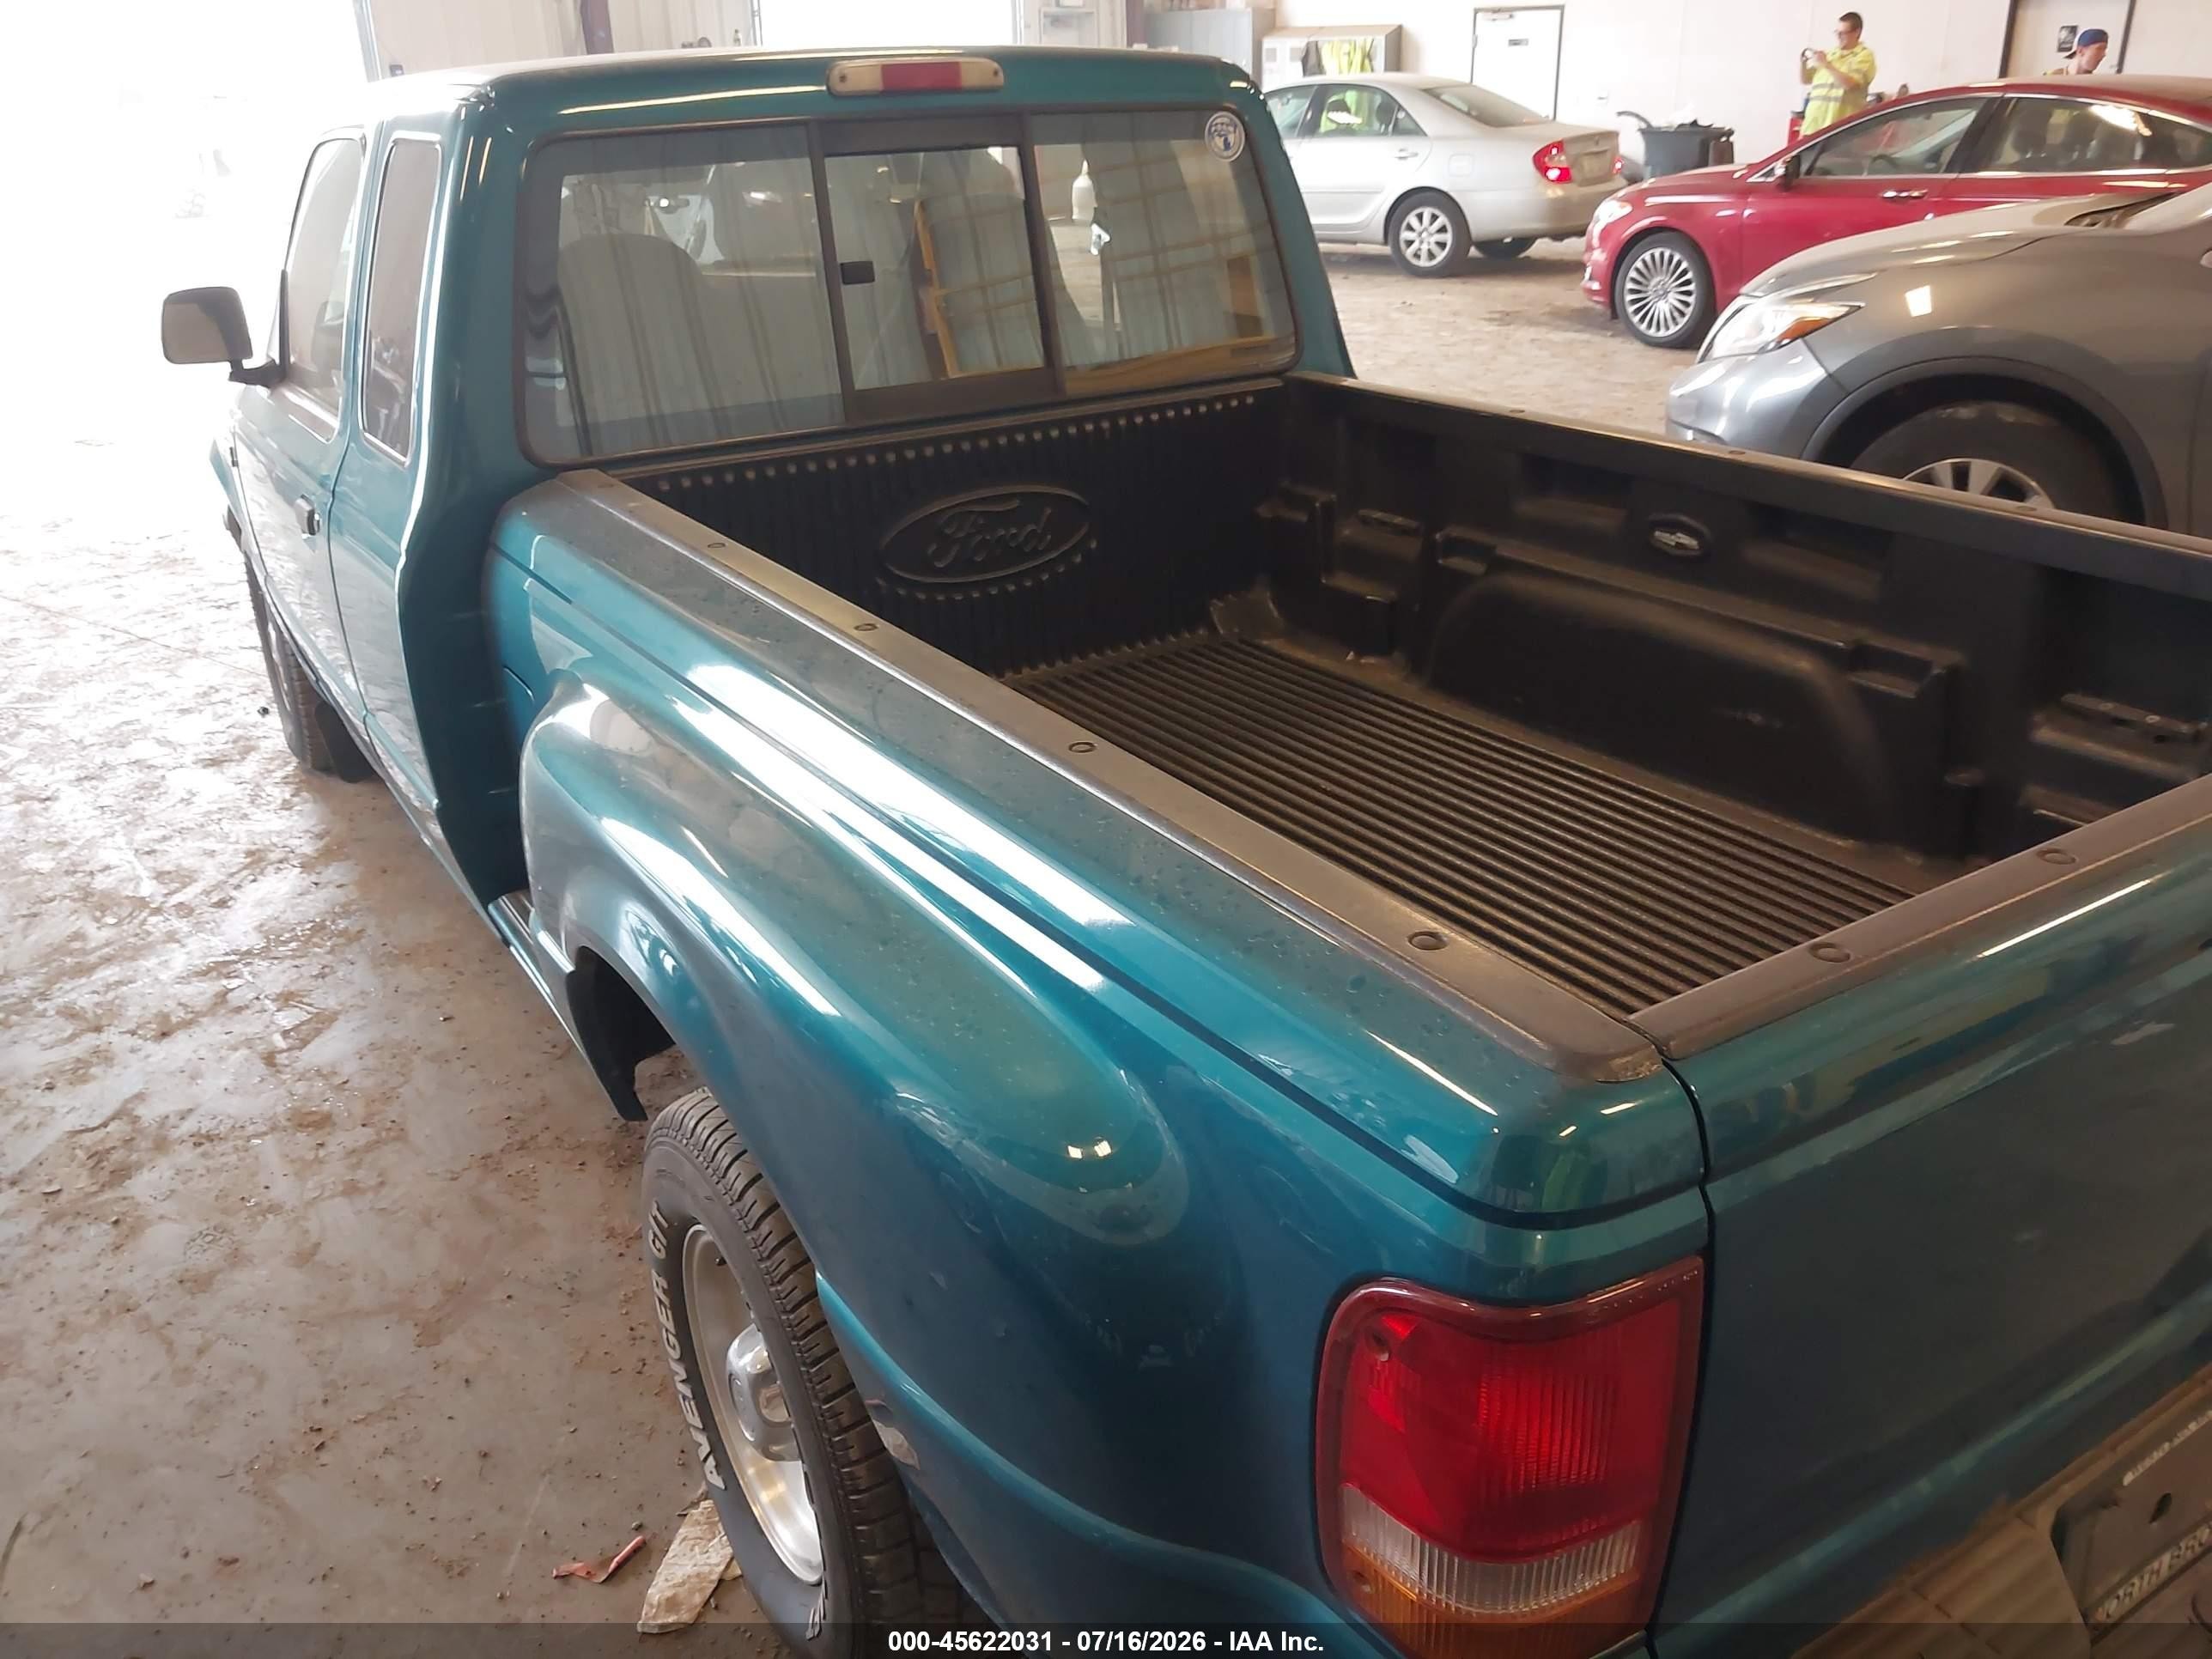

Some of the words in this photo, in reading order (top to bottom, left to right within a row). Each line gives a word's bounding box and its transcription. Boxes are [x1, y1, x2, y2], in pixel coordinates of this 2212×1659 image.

[927, 498, 1052, 568] Ford
[647, 1199, 669, 1260] G/T
[651, 1268, 727, 1491] AVENGER
